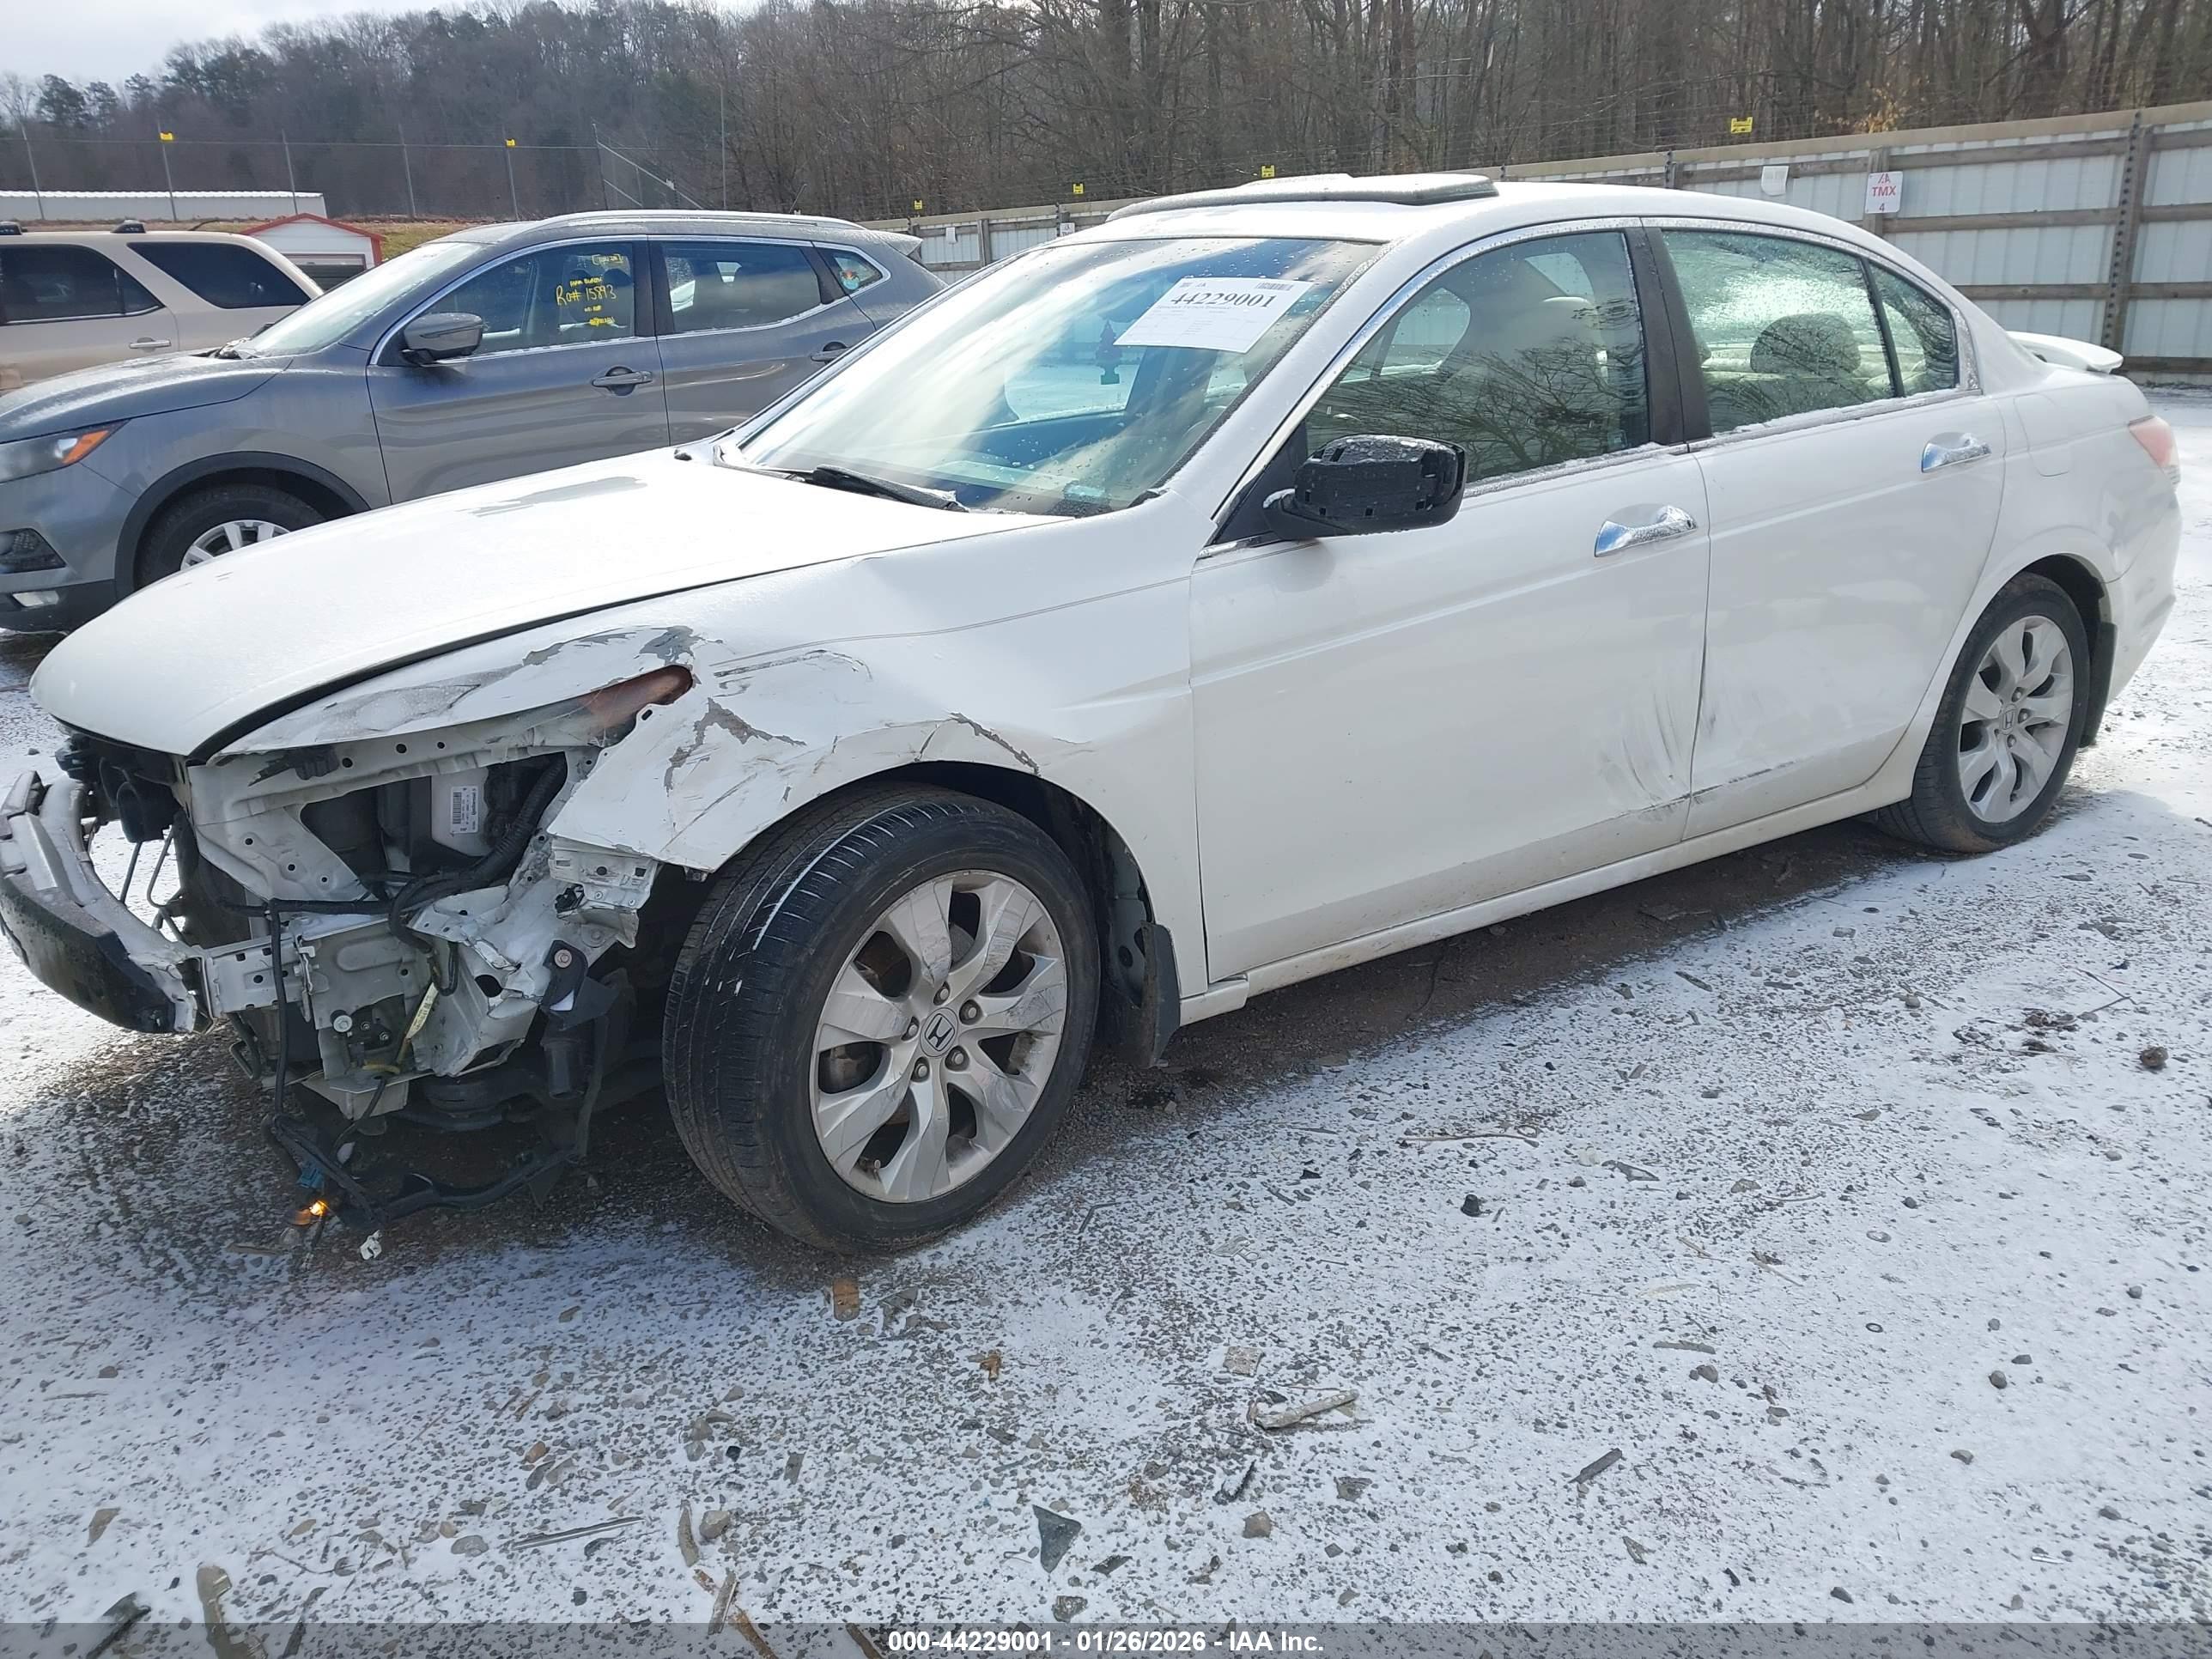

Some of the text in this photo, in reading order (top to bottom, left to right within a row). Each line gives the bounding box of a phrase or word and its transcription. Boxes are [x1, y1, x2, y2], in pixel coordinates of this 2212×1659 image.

[1872, 185, 1896, 197] TMX
[1879, 203, 1885, 211] 4
[1171, 292, 1277, 307] 44229001
